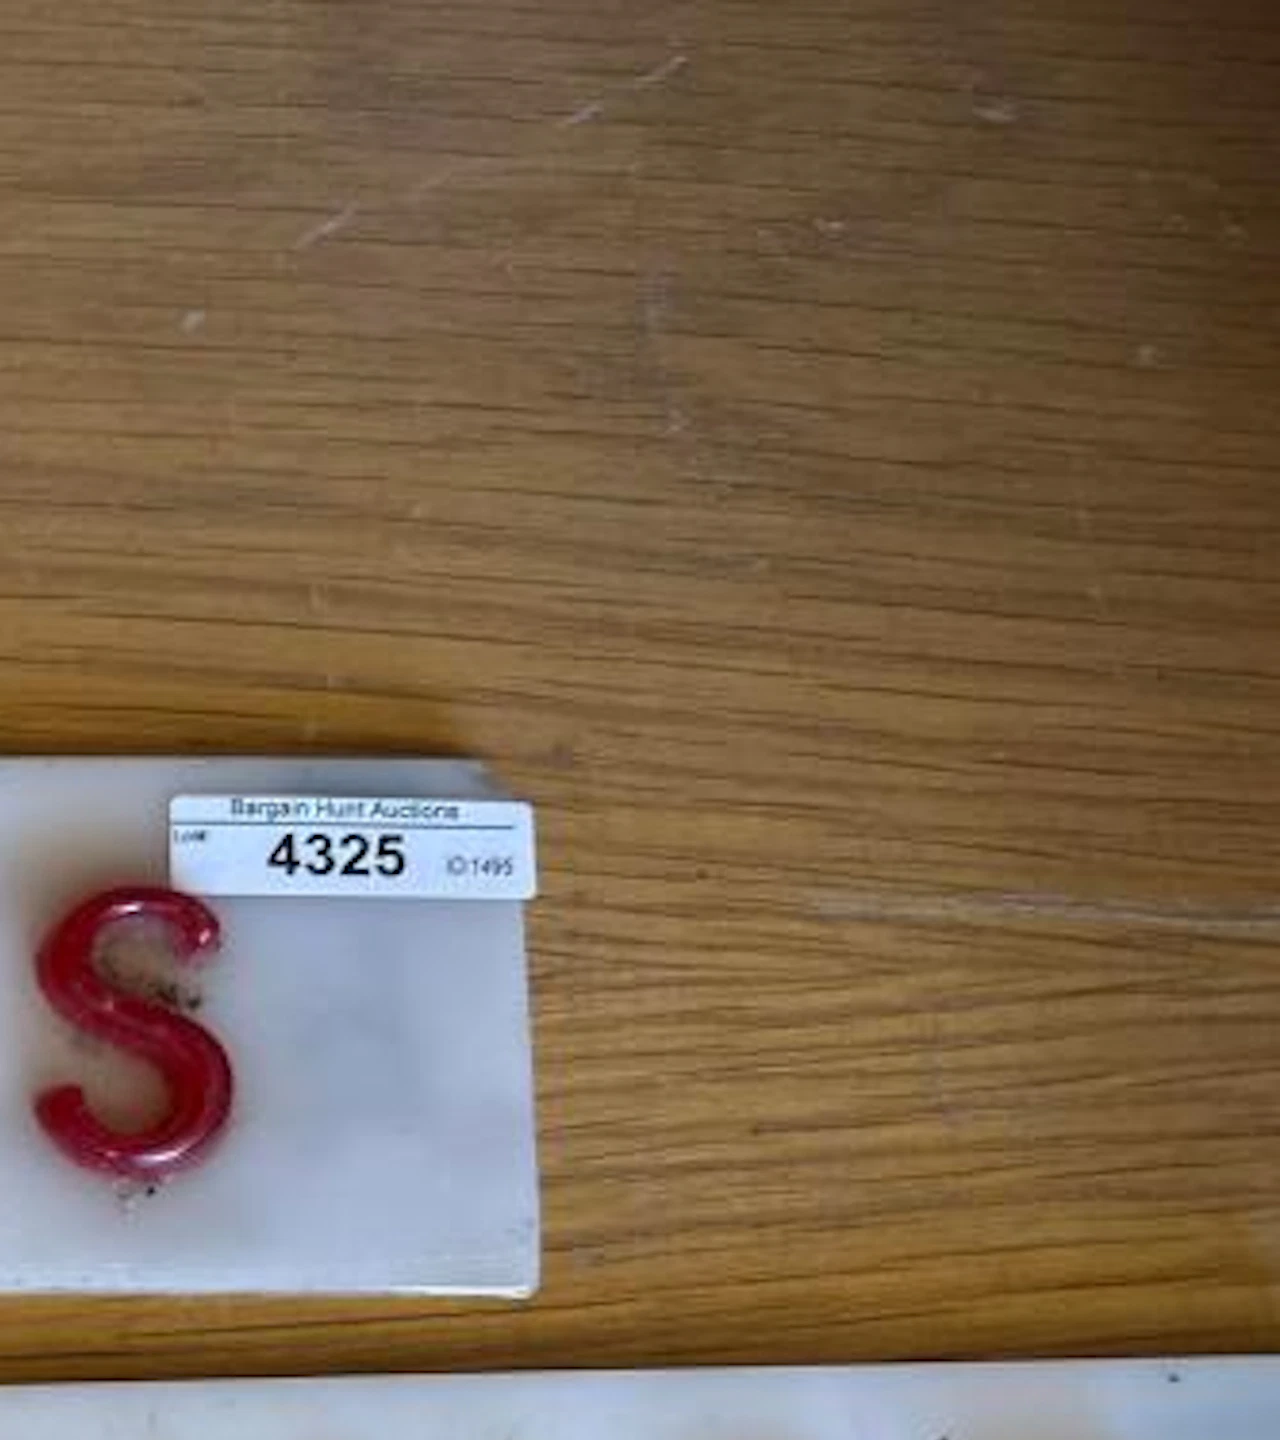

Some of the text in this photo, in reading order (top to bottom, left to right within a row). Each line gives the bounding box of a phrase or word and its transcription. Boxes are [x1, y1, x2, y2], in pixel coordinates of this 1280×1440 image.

[231, 797, 459, 823] Bargain Hunt Auctions
[267, 832, 405, 877] 4325
